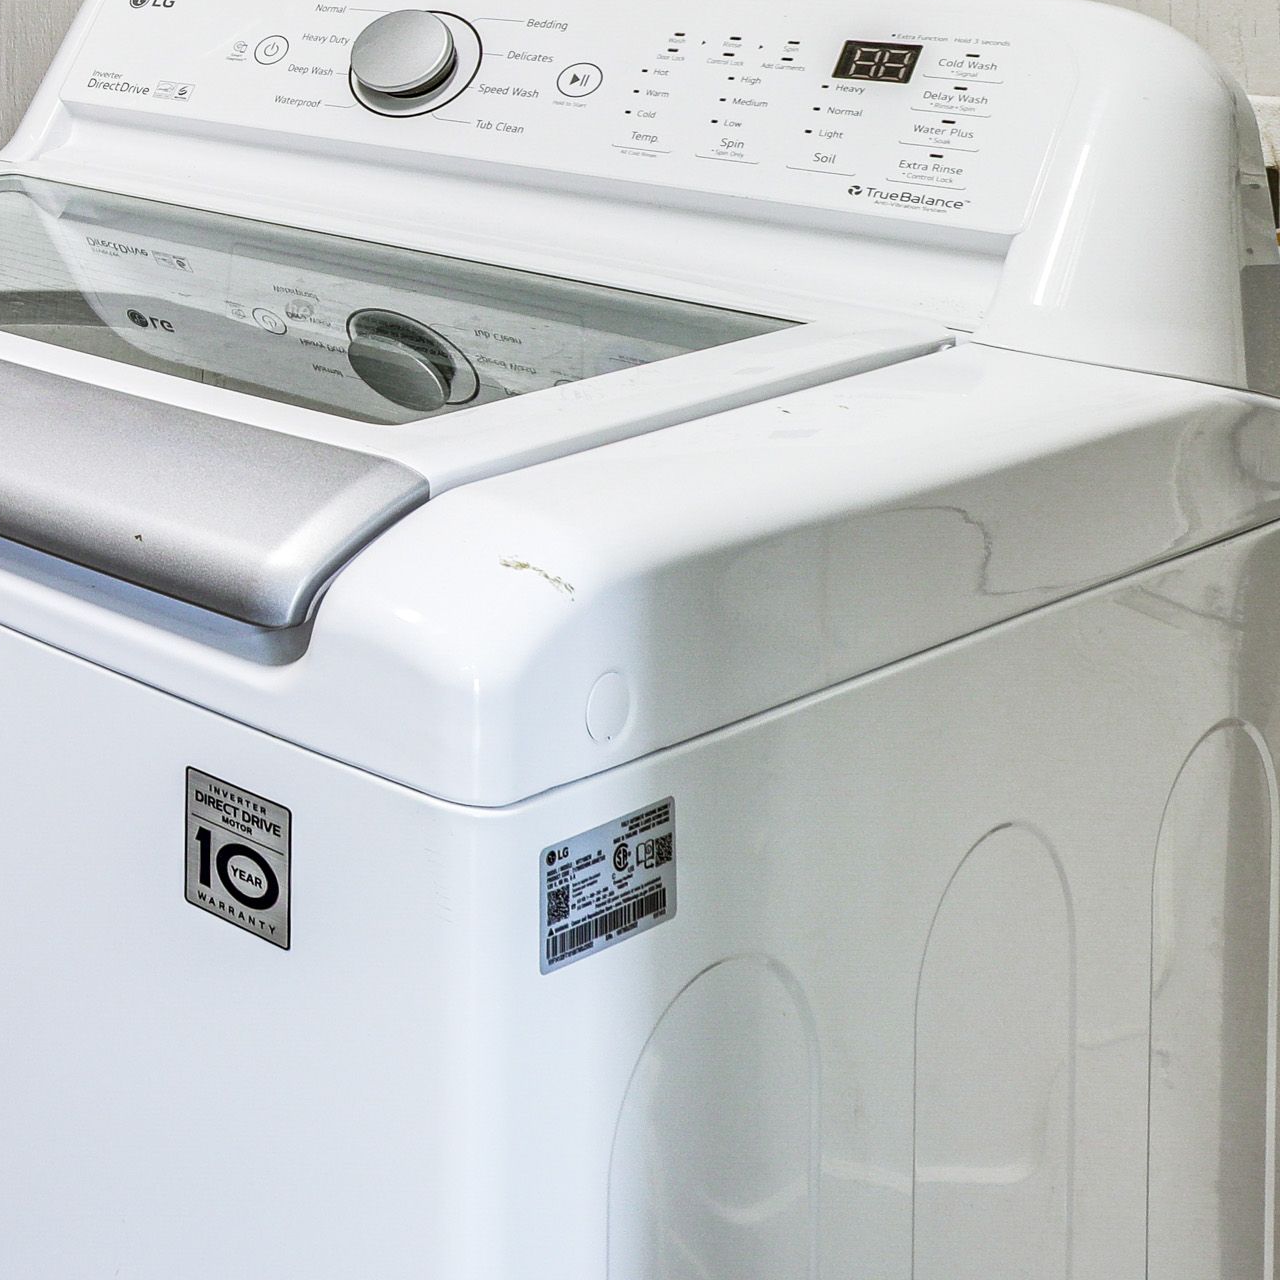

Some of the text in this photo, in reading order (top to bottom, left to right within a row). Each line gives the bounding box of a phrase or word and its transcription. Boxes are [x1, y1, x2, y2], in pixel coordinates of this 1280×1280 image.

[315, 3, 347, 14] Normal
[526, 18, 569, 32] Bedding
[302, 33, 351, 46] Heavy Duty
[917, 34, 948, 42] Function
[954, 37, 972, 45] Hold
[981, 39, 1011, 47] seconds
[507, 50, 555, 64] Delicates
[288, 63, 334, 76] Deep Wash
[938, 58, 998, 72] Cold Wash
[92, 70, 123, 80] Inverter
[653, 68, 670, 77] Hot
[741, 76, 762, 86] High
[478, 84, 540, 99] Speed Wash
[645, 88, 670, 98] Warm
[835, 84, 866, 95] Heavy
[274, 95, 322, 109] Waterproof
[732, 97, 769, 108] Medium
[922, 90, 989, 105] Delay Wash
[636, 109, 657, 119] Cold
[827, 106, 863, 117] Normal
[475, 119, 525, 135] Tub Clean
[723, 119, 742, 128] Low
[818, 128, 844, 140] Light
[913, 124, 975, 140] Water Plus
[720, 137, 745, 150] Spin
[812, 152, 837, 165] Soil
[898, 159, 964, 176] Extra Rinse
[906, 172, 954, 185] Control Lock
[873, 199, 948, 214] Anti-Vibration System
[208, 783, 267, 816] INVERTER
[194, 789, 282, 838] DIRECT DRIVE
[221, 815, 253, 836] MOTOR
[558, 846, 569, 861] LG
[194, 825, 280, 911] 10
[230, 864, 264, 890] YEAR
[197, 889, 277, 936] WARRANTY
